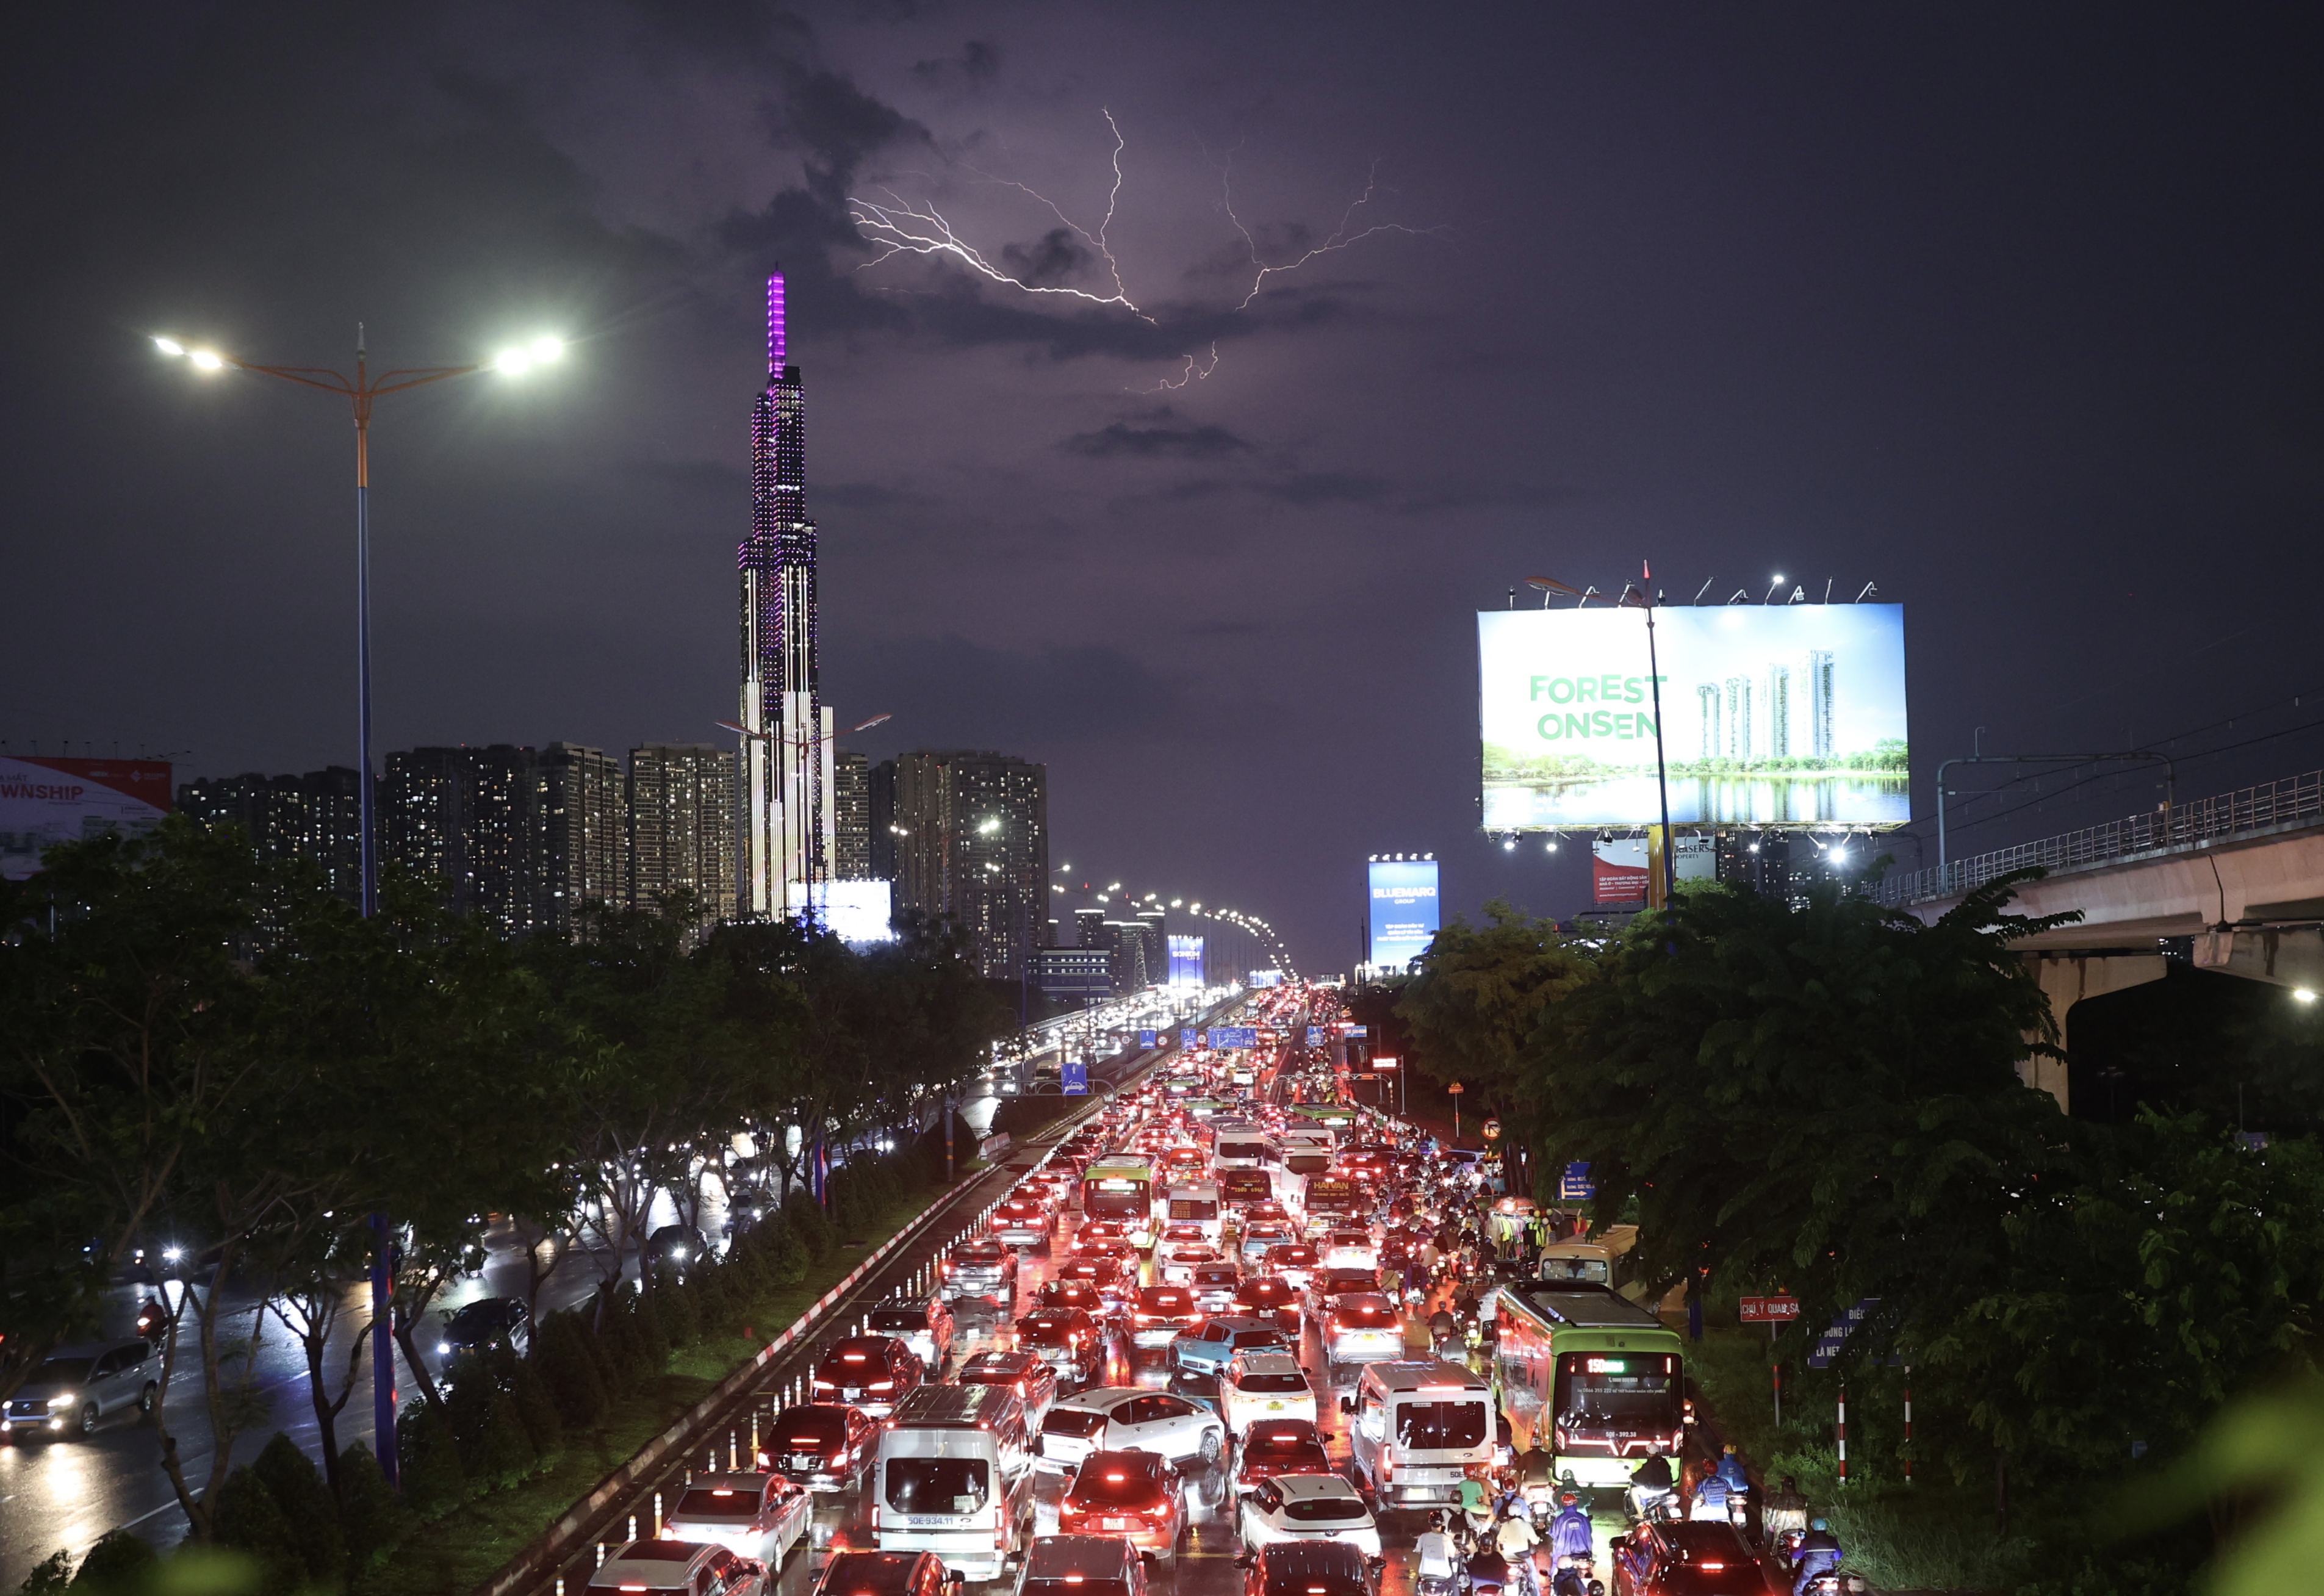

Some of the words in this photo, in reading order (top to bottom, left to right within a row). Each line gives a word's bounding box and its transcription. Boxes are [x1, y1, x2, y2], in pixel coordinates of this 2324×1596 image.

[1530, 674, 1667, 704] FOREST
[1537, 710, 1659, 740] ONSEN
[1373, 887, 1436, 898] BLUEMARQ
[1742, 1302, 1756, 1314] CHÚ
[1768, 1303, 1787, 1314] QUAN
[1588, 1359, 1605, 1372] 150
